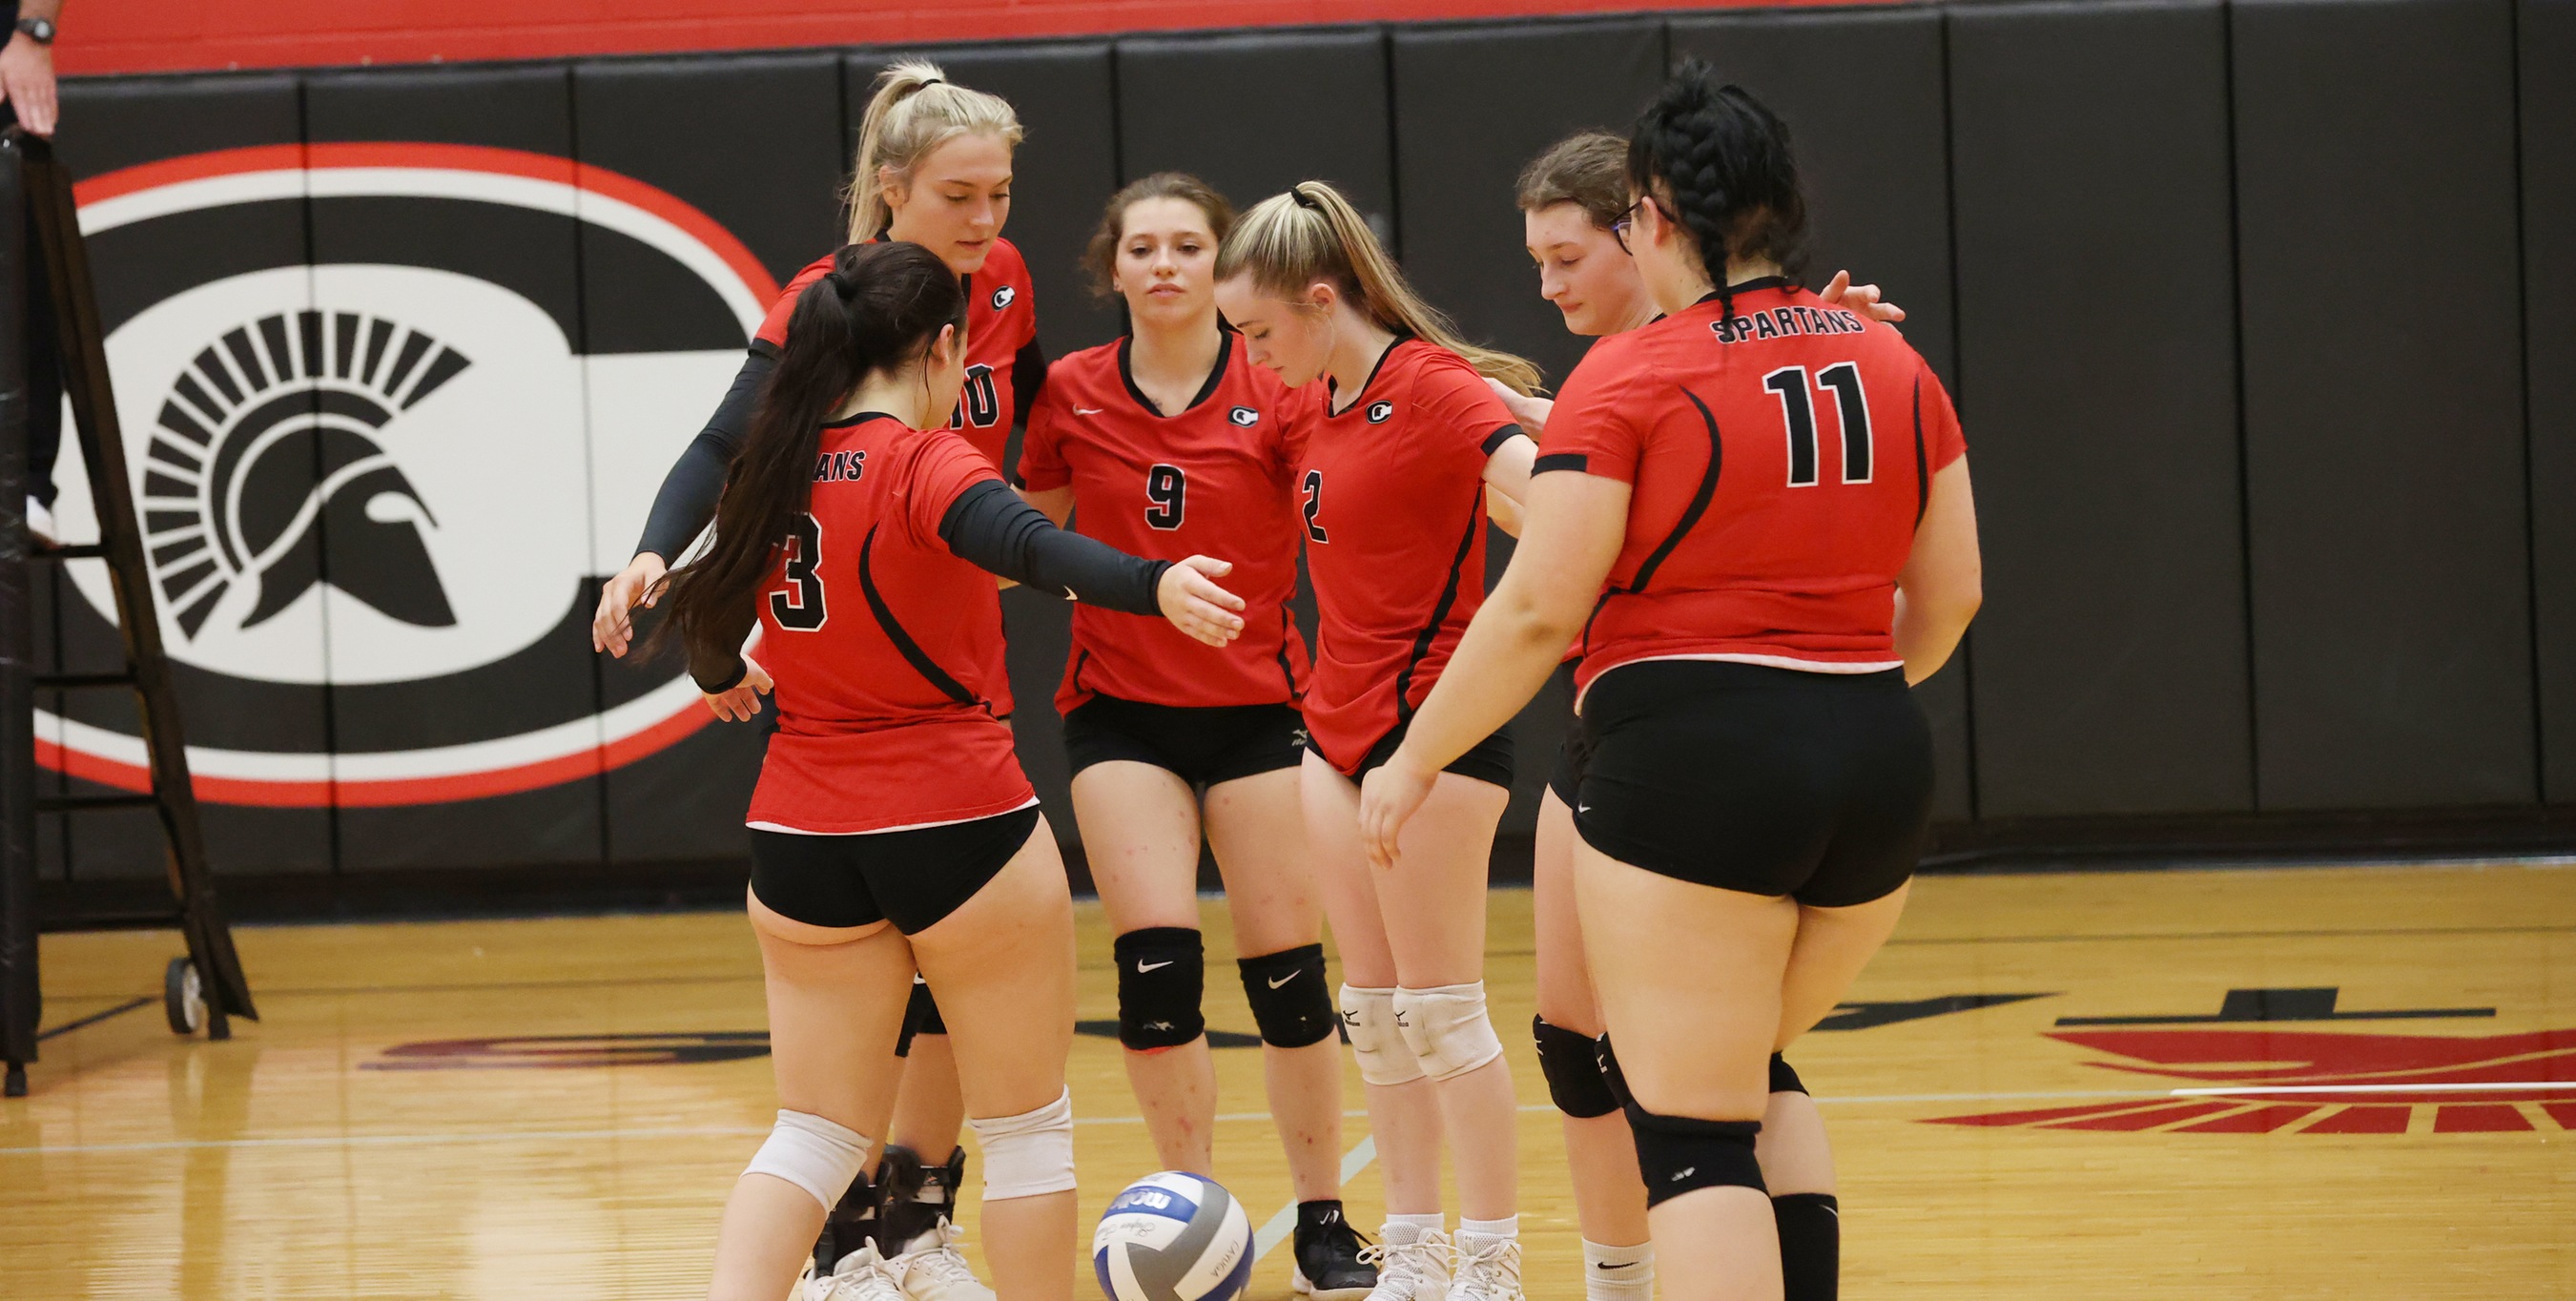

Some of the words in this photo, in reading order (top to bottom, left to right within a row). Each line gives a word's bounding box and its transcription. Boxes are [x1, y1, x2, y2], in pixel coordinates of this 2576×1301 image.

[1709, 305, 1865, 344] SPARTANS
[1762, 361, 1873, 488] 11
[813, 449, 867, 483] ANS
[1145, 463, 1186, 531] 9
[1302, 468, 1329, 545] 2
[769, 511, 828, 632] 3
